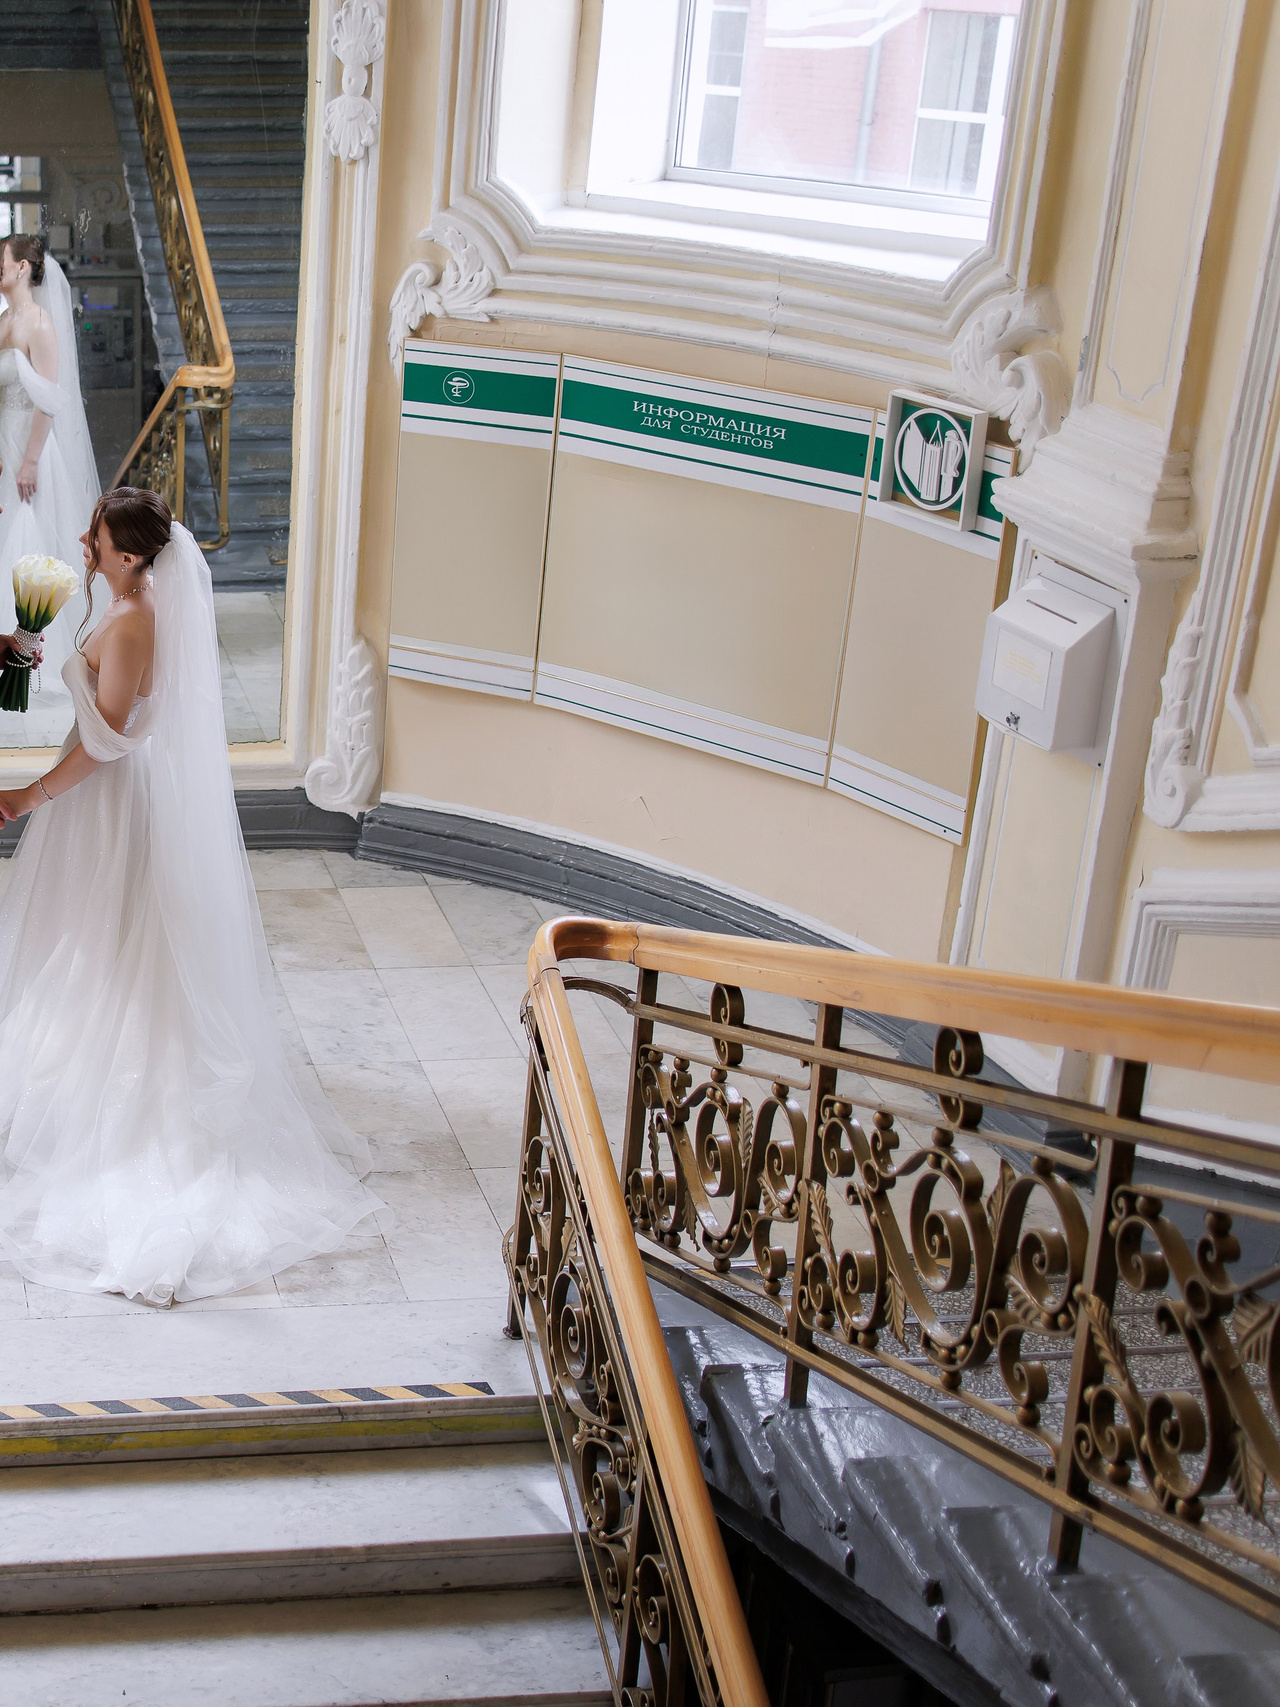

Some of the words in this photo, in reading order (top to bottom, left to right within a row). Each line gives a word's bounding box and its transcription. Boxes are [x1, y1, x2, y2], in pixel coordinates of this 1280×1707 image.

[633, 400, 787, 440] ИНФОРМАЦИЯ
[640, 416, 671, 430] ДЛЯ
[680, 424, 774, 450] СТУДЕНТОВ
